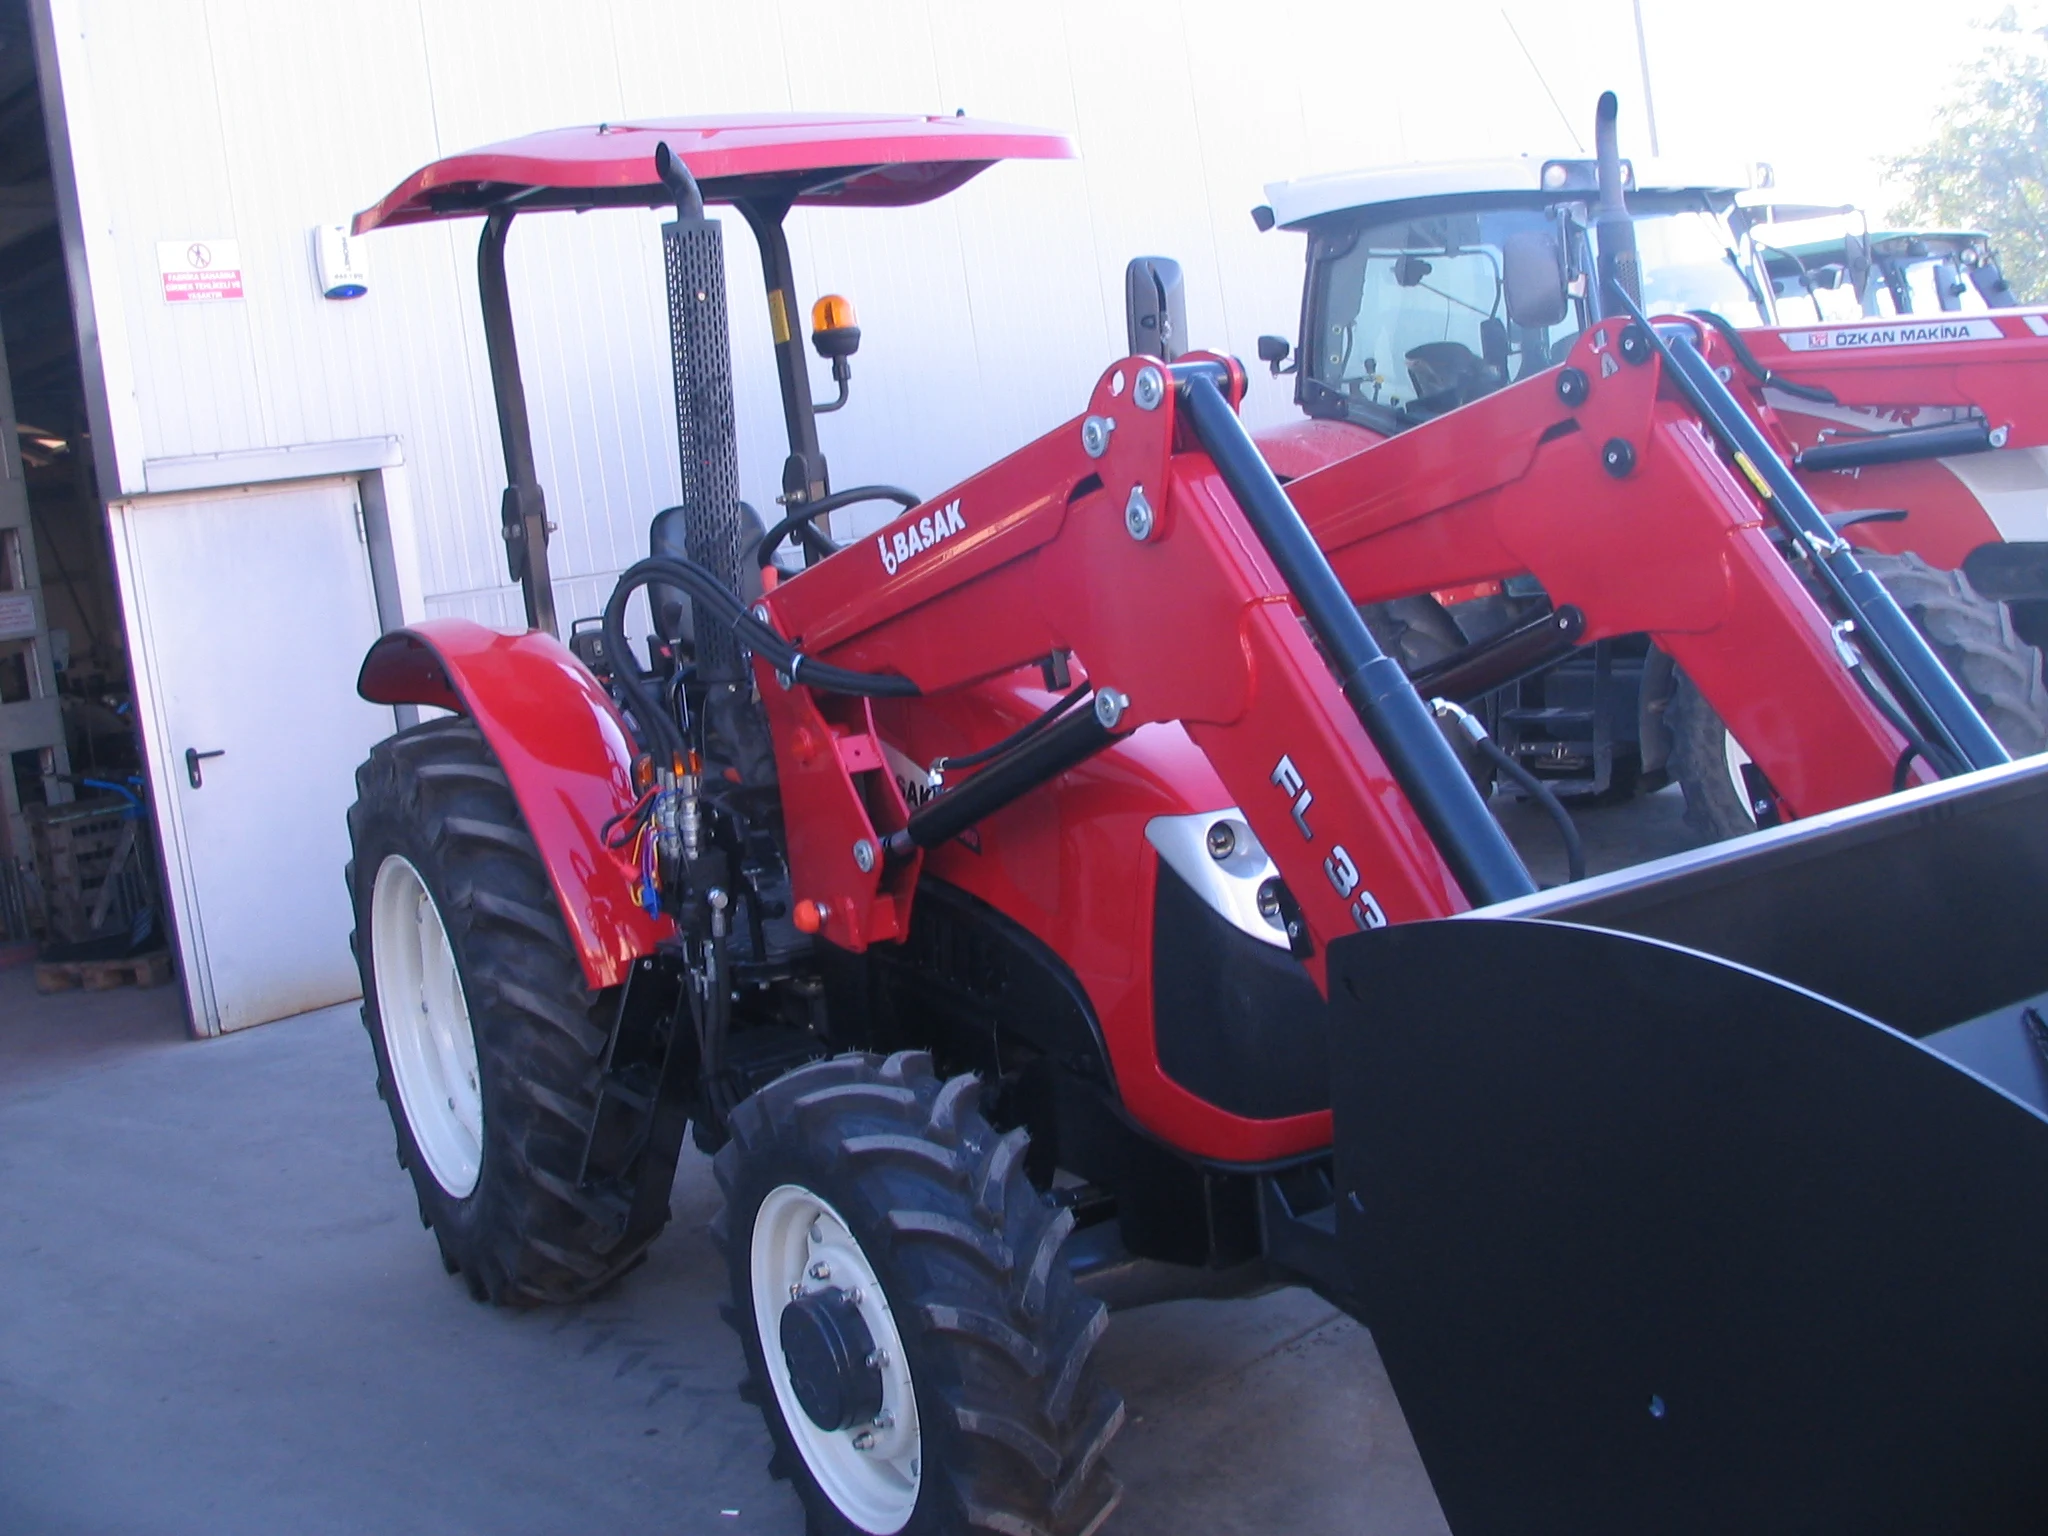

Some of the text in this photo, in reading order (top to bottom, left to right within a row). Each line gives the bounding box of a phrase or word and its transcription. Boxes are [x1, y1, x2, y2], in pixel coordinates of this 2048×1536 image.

[1835, 325, 1970, 346] ÖZKAN MAKİNA
[1269, 754, 1314, 841] FL
